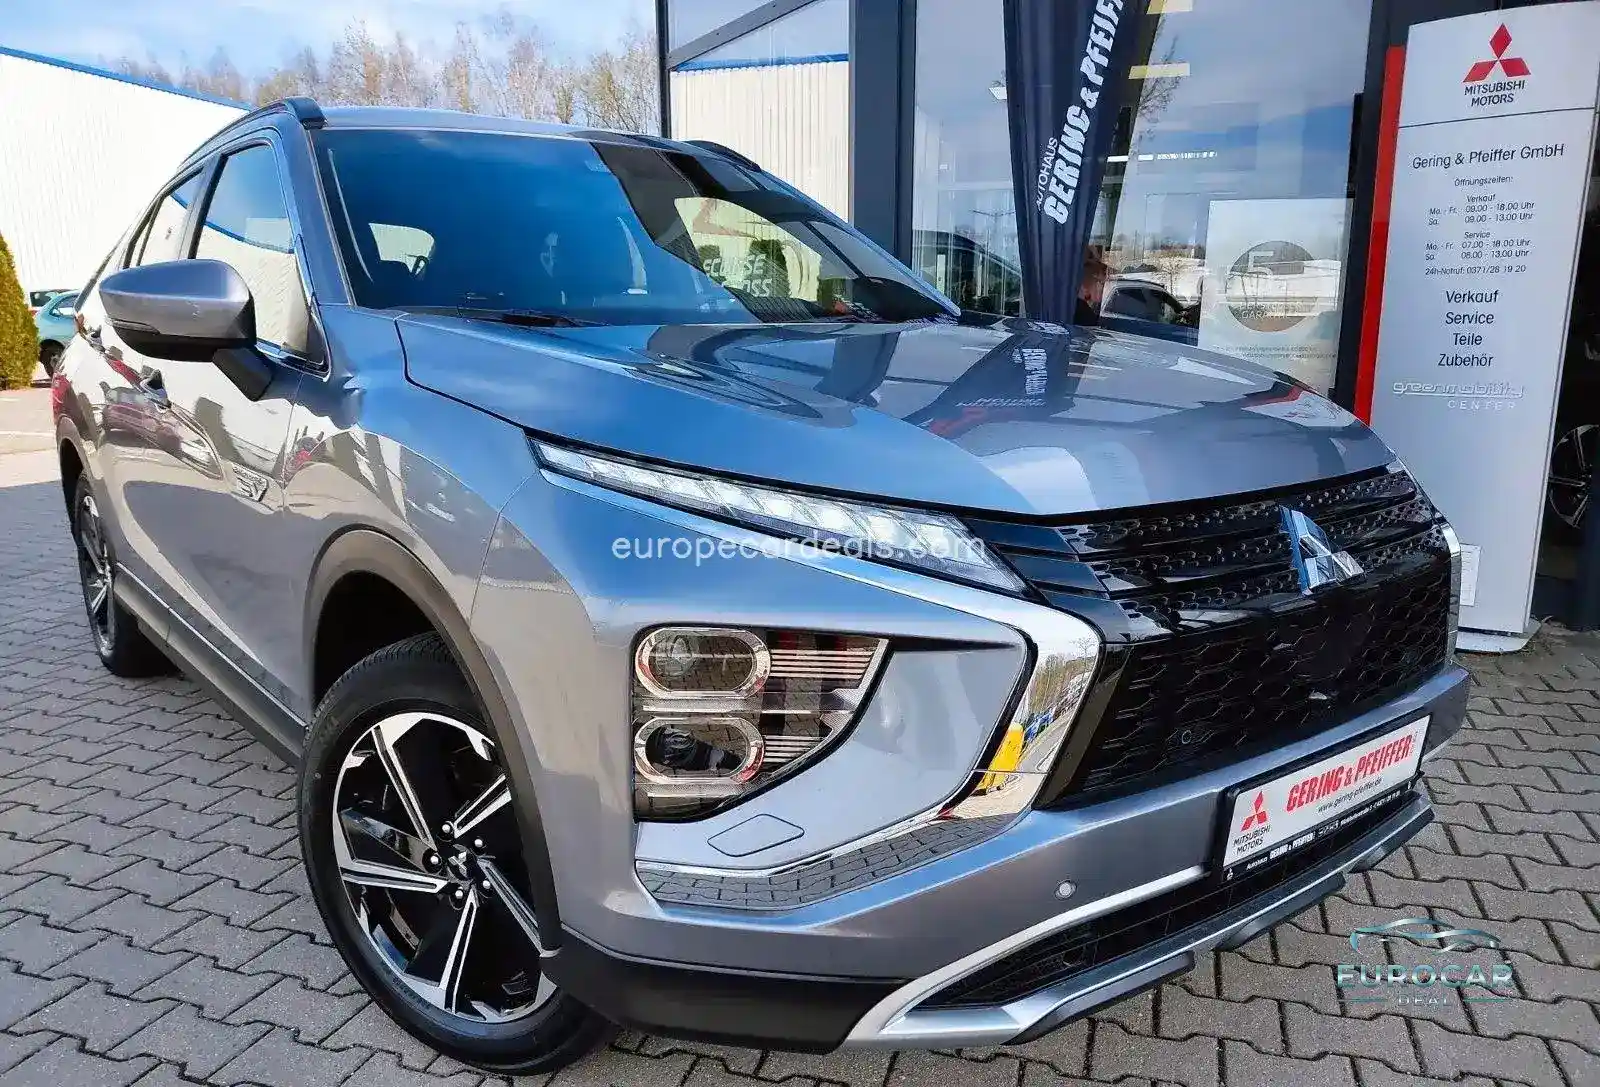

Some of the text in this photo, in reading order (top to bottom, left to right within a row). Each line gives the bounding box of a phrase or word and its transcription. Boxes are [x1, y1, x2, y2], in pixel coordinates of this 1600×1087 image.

[1464, 80, 1526, 96] MITSUBISHI
[1471, 93, 1515, 107] MOTORS
[1044, 0, 1123, 224] GERING & PFEIF
[1412, 144, 1565, 170] Gering & Pfeiffer GmbH
[1036, 137, 1058, 211] AUTOHAUS
[1454, 176, 1514, 188] Öffnungszeiten:
[1467, 194, 1496, 203] Verkauf
[1465, 204, 1488, 213] 09.00
[1497, 202, 1518, 211] 18.00
[1521, 202, 1535, 210] Uhr
[1464, 215, 1487, 223] 09.00
[1496, 213, 1517, 222] 13.00
[1519, 212, 1534, 220] Uhr
[1464, 231, 1491, 239] Service
[1461, 240, 1483, 249] 07.00
[1516, 238, 1531, 247] Uhr
[1491, 249, 1513, 258] 13.00
[1515, 249, 1530, 257] Uhr
[1425, 266, 1465, 276] 24h-Notruf:
[1515, 265, 1526, 273] 20
[1446, 289, 1500, 304] Verkauf
[1445, 311, 1495, 325] Service
[1453, 332, 1483, 346] Teile
[1438, 353, 1494, 367] Zubehör
[1286, 765, 1345, 812] GERING
[1344, 767, 1353, 787] &
[1354, 734, 1413, 782] PFEIFFER
[1233, 825, 1271, 847] MITSUBISHI
[1236, 837, 1264, 856] MOTORS
